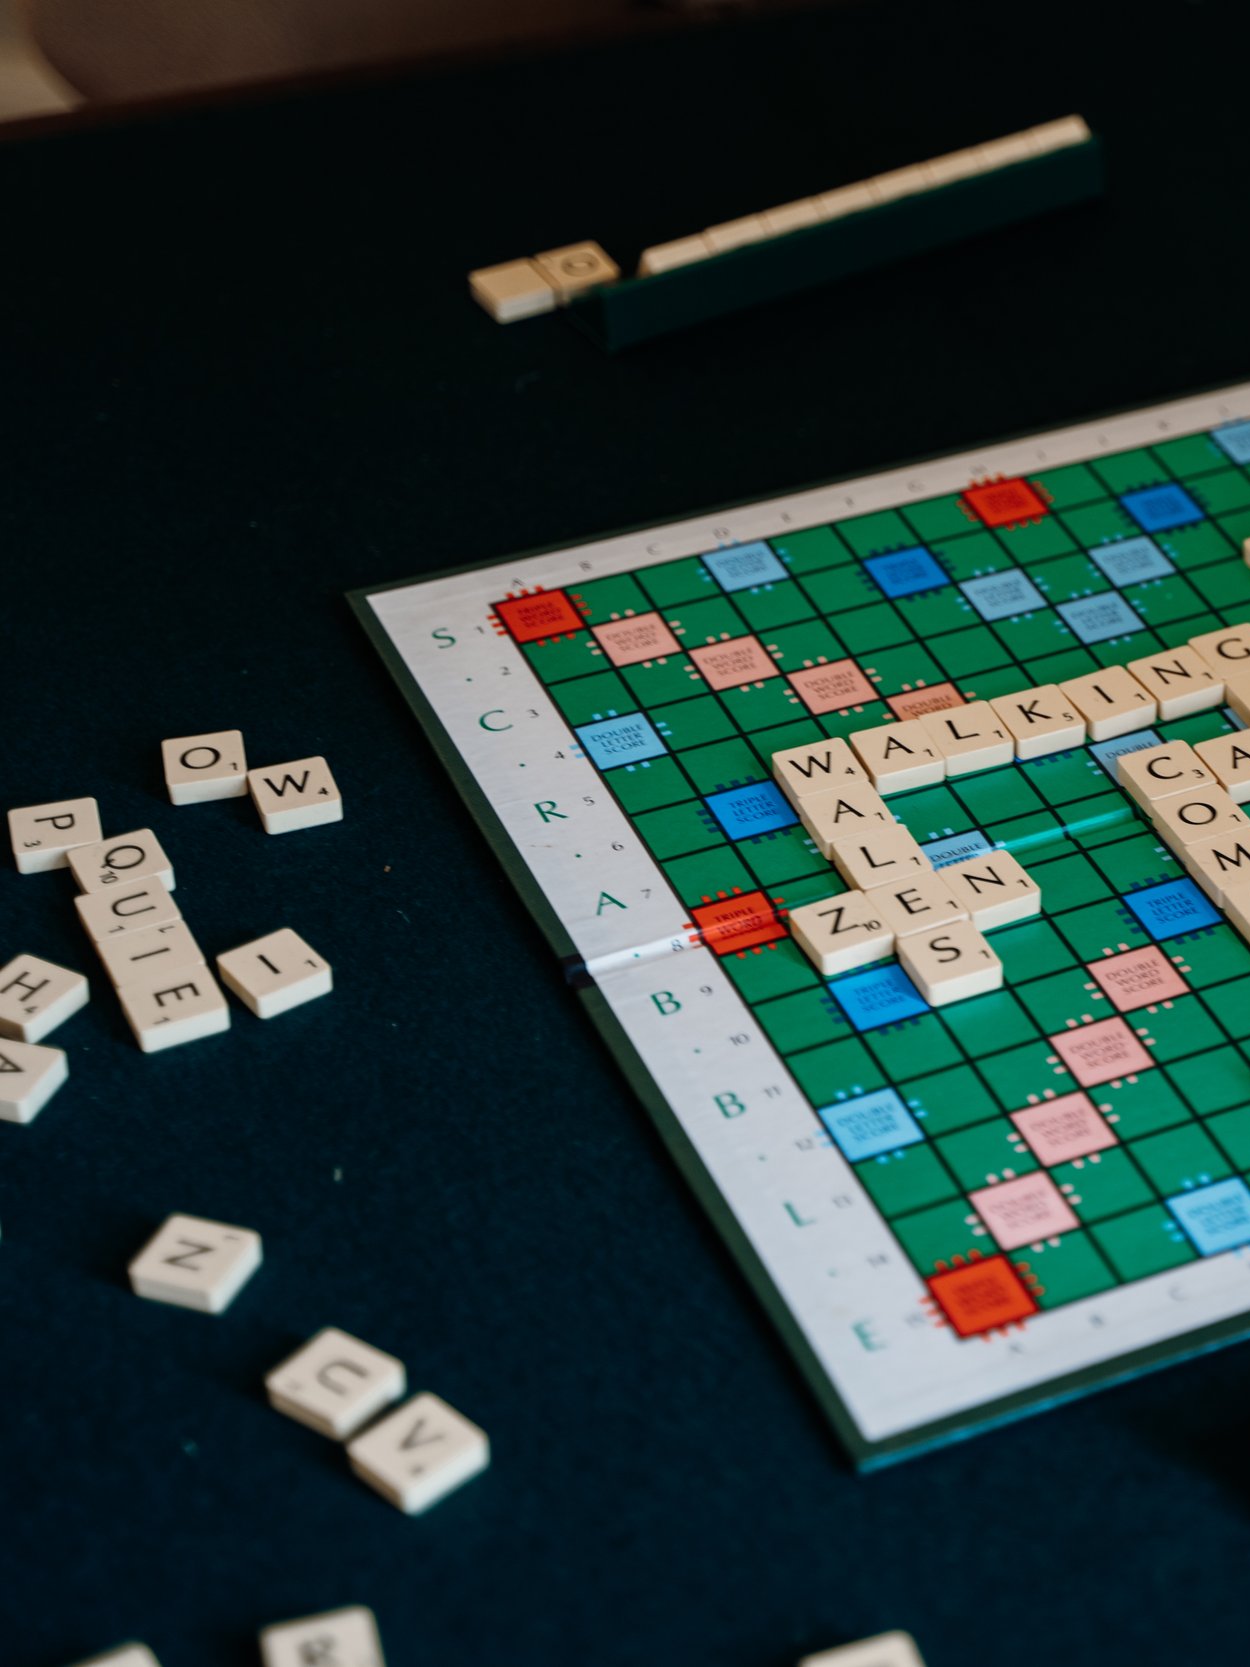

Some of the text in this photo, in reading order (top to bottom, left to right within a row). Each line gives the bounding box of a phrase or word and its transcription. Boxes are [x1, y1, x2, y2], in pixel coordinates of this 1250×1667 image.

[802, 670, 855, 690] DOUBLE
[811, 678, 855, 695] WORD
[816, 684, 860, 702] SCORE
[527, 708, 538, 717] 3
[901, 693, 954, 714] DOUBLE
[589, 724, 644, 745] DOUBLE
[599, 732, 644, 750] LETTER
[553, 751, 565, 760] 4
[603, 739, 648, 757] SCORE
[1103, 740, 1155, 760] DOUBLE
[583, 796, 594, 805] 5
[727, 793, 771, 812] TRIPLE
[729, 800, 776, 819] LETTER
[734, 808, 780, 827] SCORE
[611, 841, 623, 851] 6
[641, 888, 653, 898] 7
[1145, 891, 1189, 910] TRIPLE
[712, 904, 758, 924] TRIPLE
[1149, 899, 1195, 919] LETTER
[1155, 907, 1200, 926] SCORE
[1104, 958, 1160, 982] DOUBLE
[1115, 968, 1162, 988] WORD
[700, 985, 713, 995] 9
[1121, 976, 1168, 997] SCORE
[730, 1032, 749, 1046] 10
